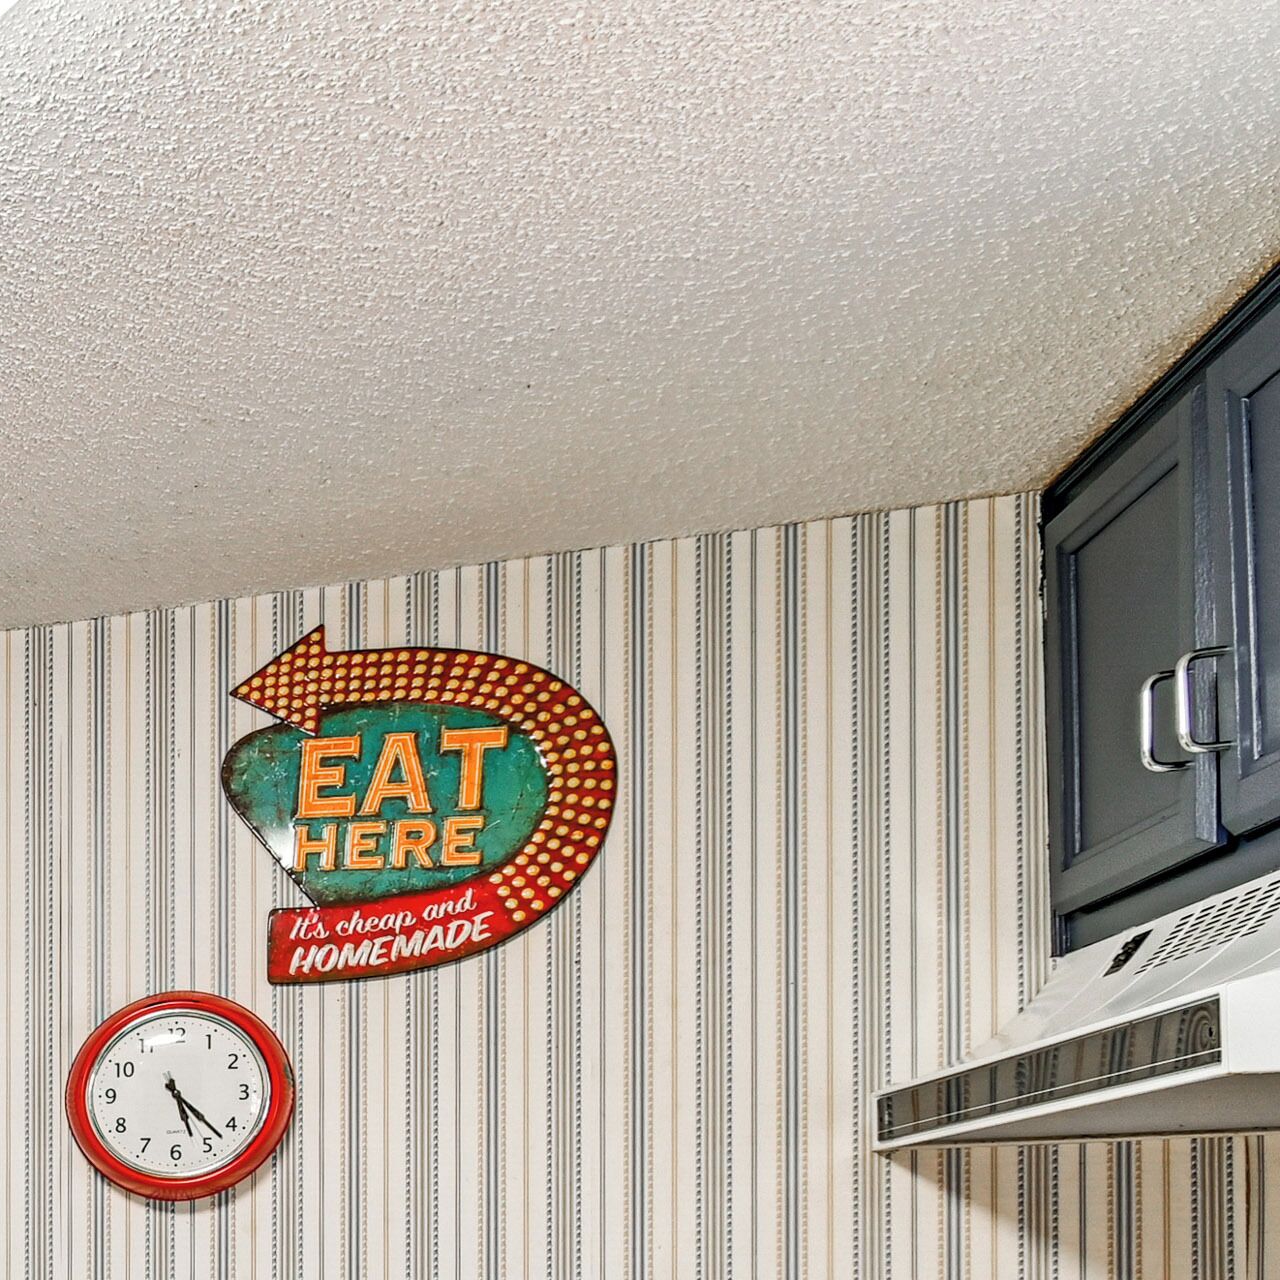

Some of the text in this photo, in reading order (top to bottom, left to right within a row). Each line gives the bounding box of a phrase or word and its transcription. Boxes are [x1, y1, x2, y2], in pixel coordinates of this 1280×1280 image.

[297, 726, 508, 818] EAT
[294, 815, 484, 872] HERE
[290, 888, 476, 940] It's cheap and
[289, 911, 494, 975] HOMEMADE
[206, 1034, 212, 1049] 1
[115, 1061, 135, 1078] 10
[228, 1054, 239, 1069] 2
[105, 1088, 117, 1104] 9
[239, 1084, 250, 1100] 3
[115, 1117, 127, 1133] 8
[225, 1117, 238, 1131] 4
[140, 1138, 151, 1153] 7
[170, 1144, 182, 1160] 6
[203, 1138, 213, 1153] 5
